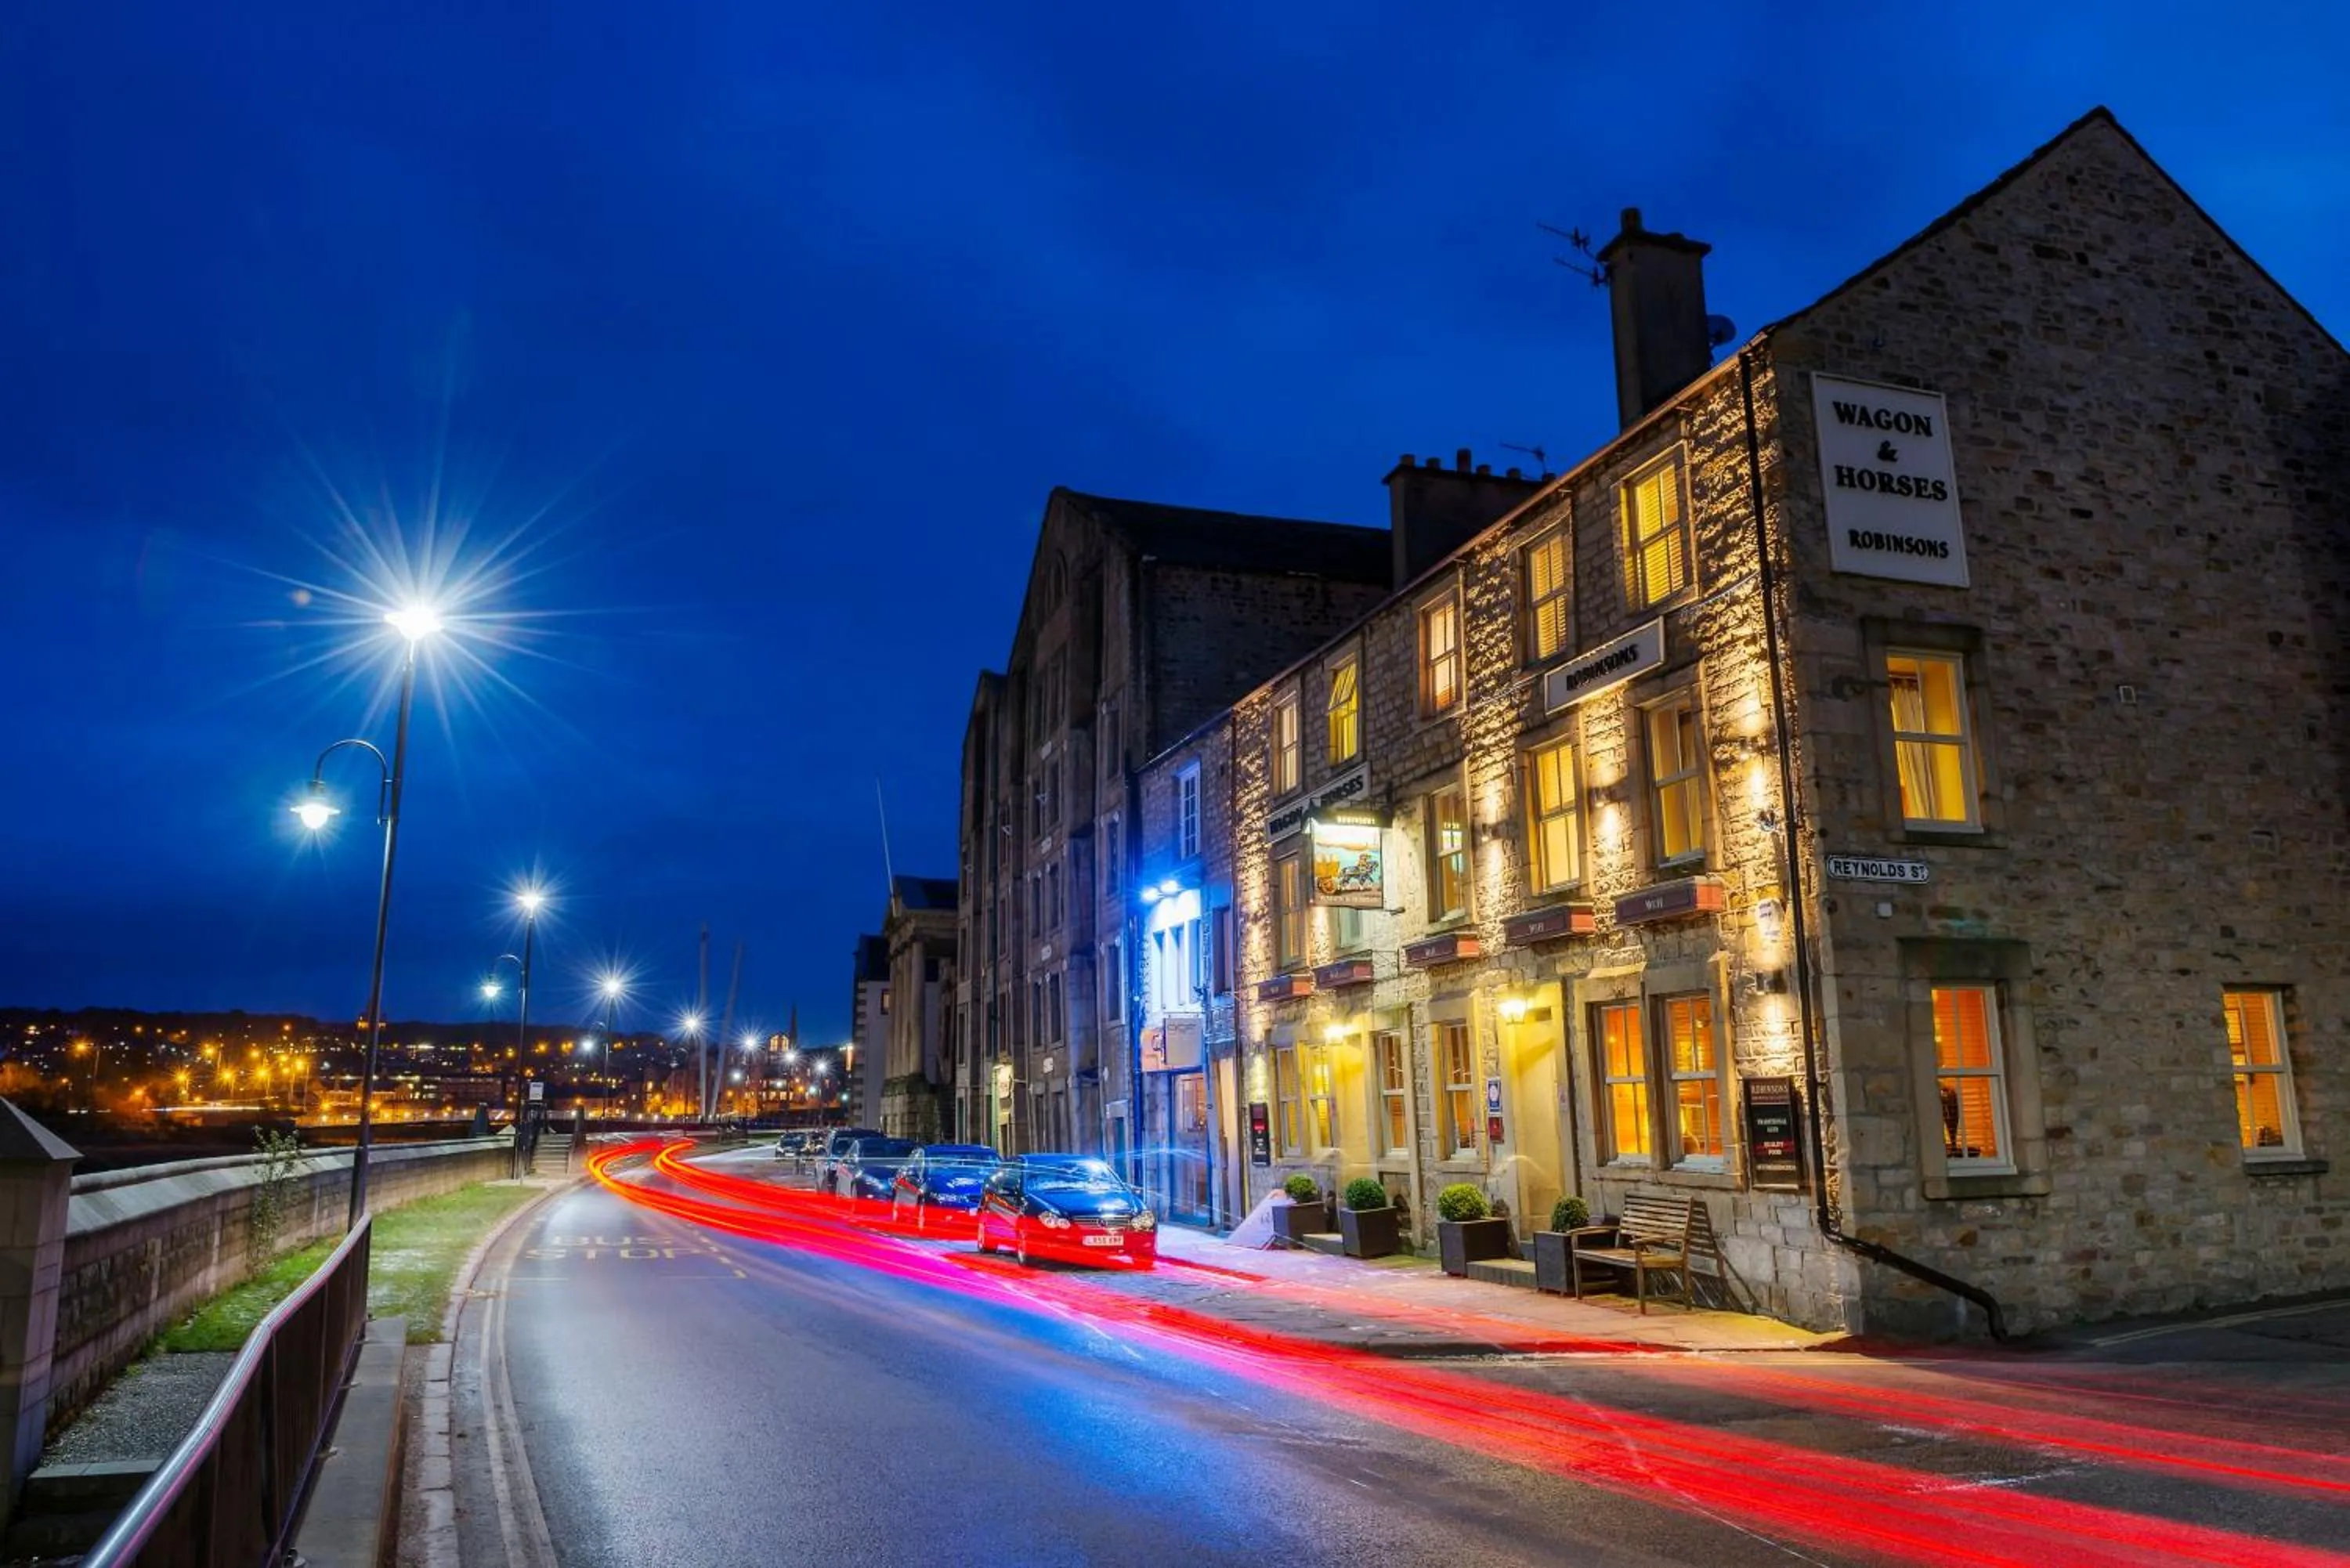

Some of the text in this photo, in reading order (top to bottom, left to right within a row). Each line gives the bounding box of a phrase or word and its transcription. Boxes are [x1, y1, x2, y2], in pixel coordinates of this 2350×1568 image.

[1832, 401, 1933, 437] WAGON
[1878, 440, 1898, 462] &
[1834, 464, 1947, 501] HORSES
[1849, 529, 1949, 558] ROBINSONS
[1566, 643, 1640, 691] ROBINSONS
[1834, 861, 1906, 878] REYNOLDS
